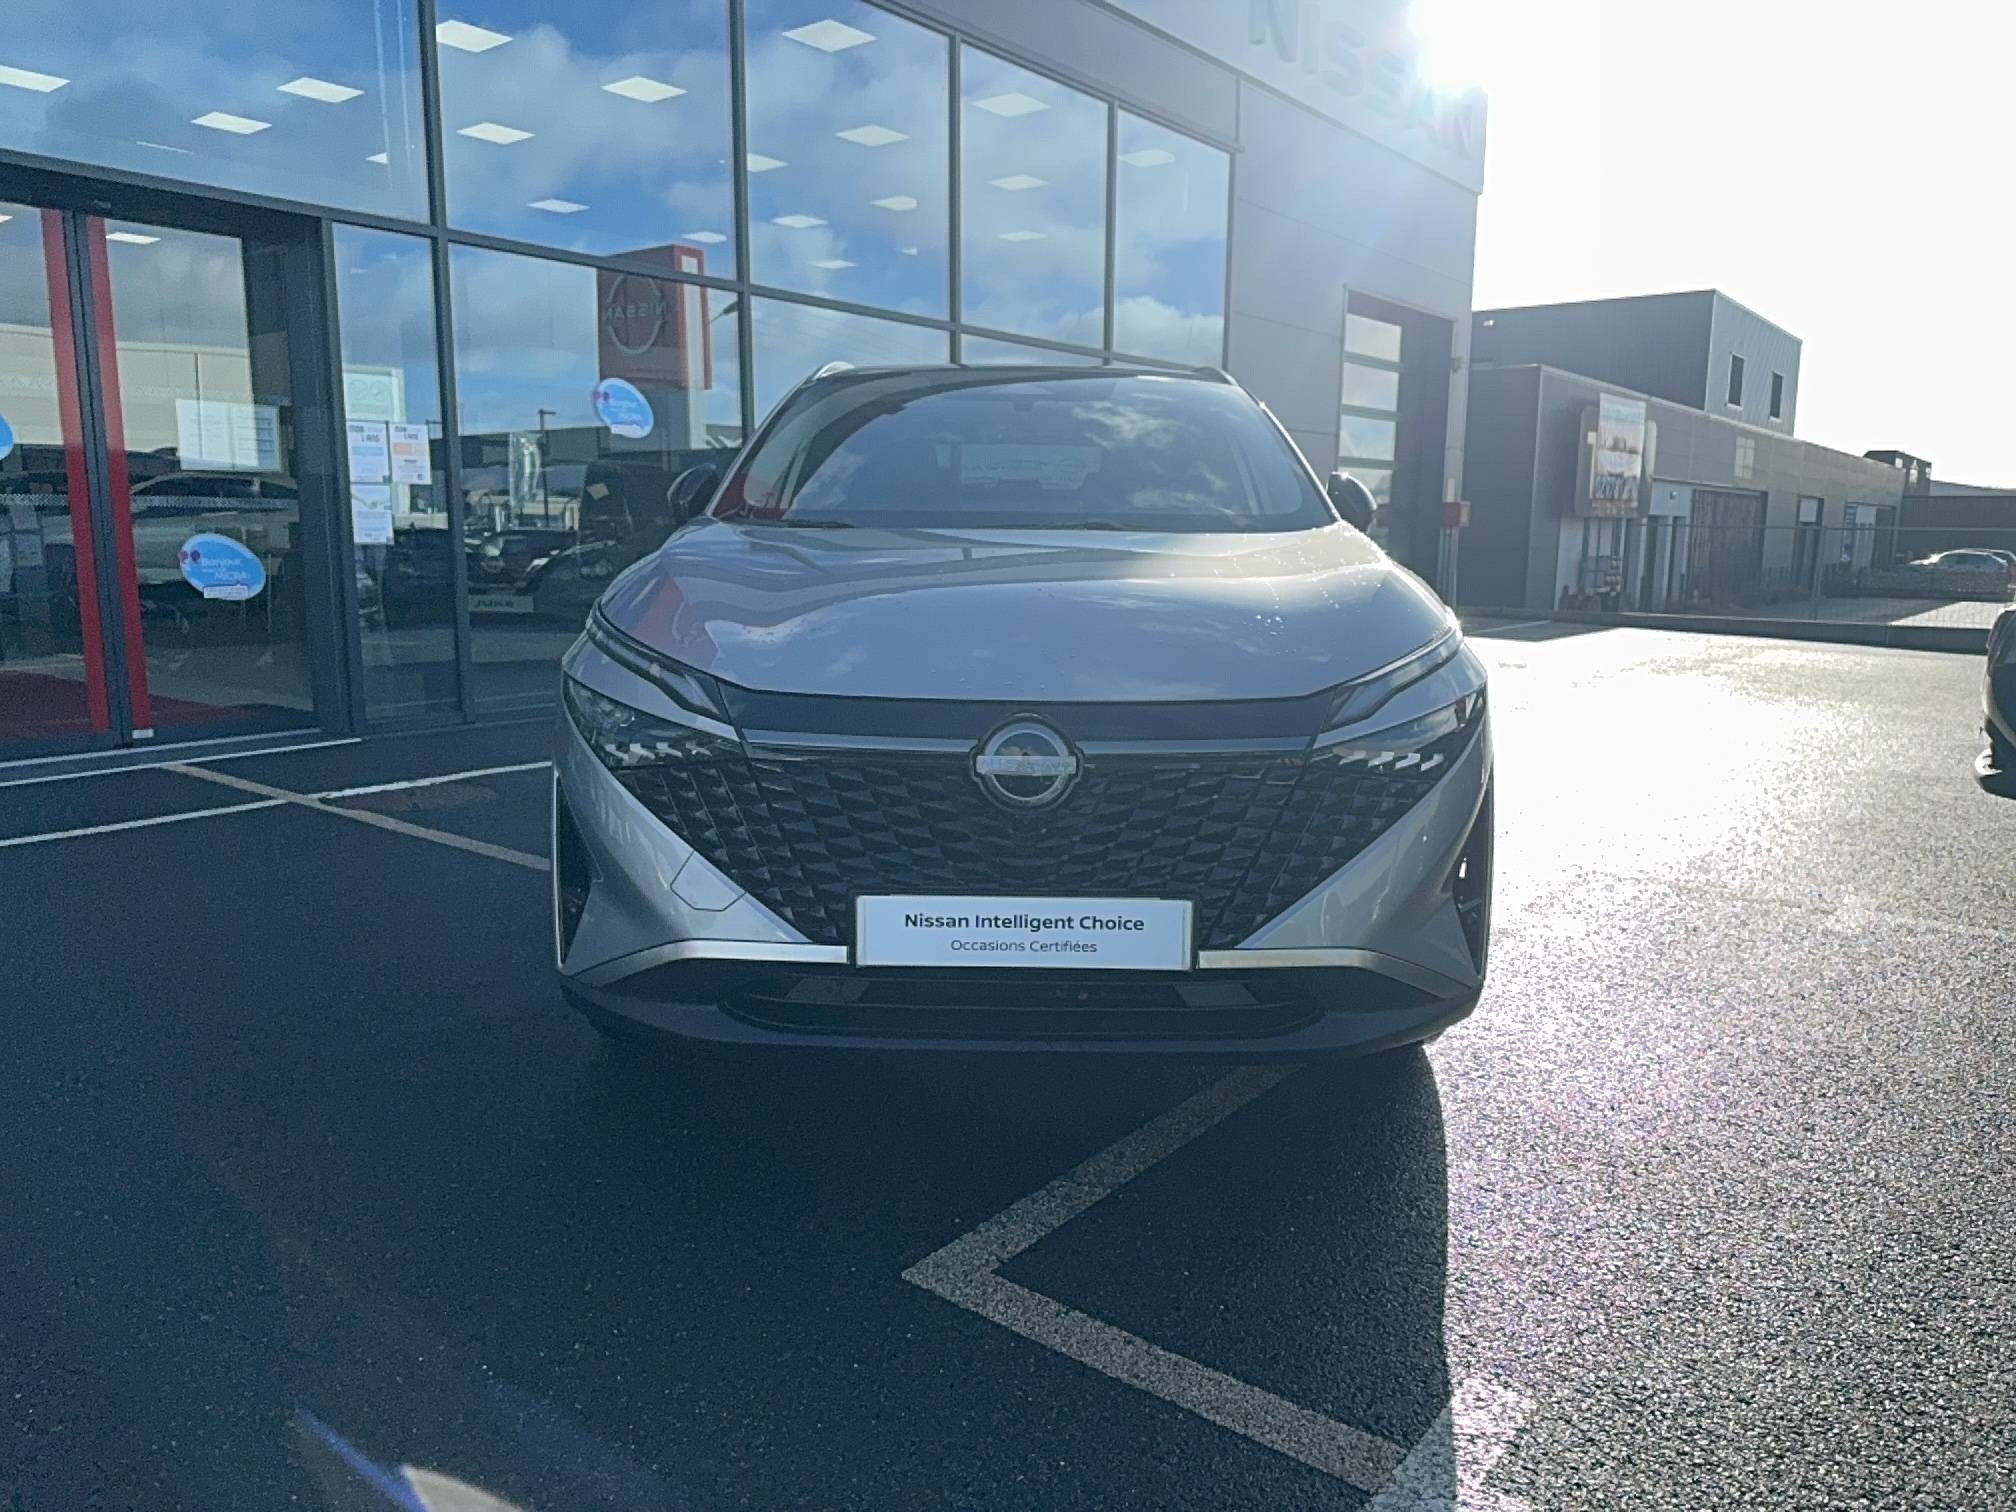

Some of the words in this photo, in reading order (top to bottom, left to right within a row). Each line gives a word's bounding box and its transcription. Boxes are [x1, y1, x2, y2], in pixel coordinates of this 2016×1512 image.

[905, 913, 969, 928] Nissan
[975, 914, 1074, 932] Intelligent
[1079, 915, 1145, 931] Choice
[951, 940, 1026, 952] Occasions
[1029, 940, 1098, 953] Certifiées
